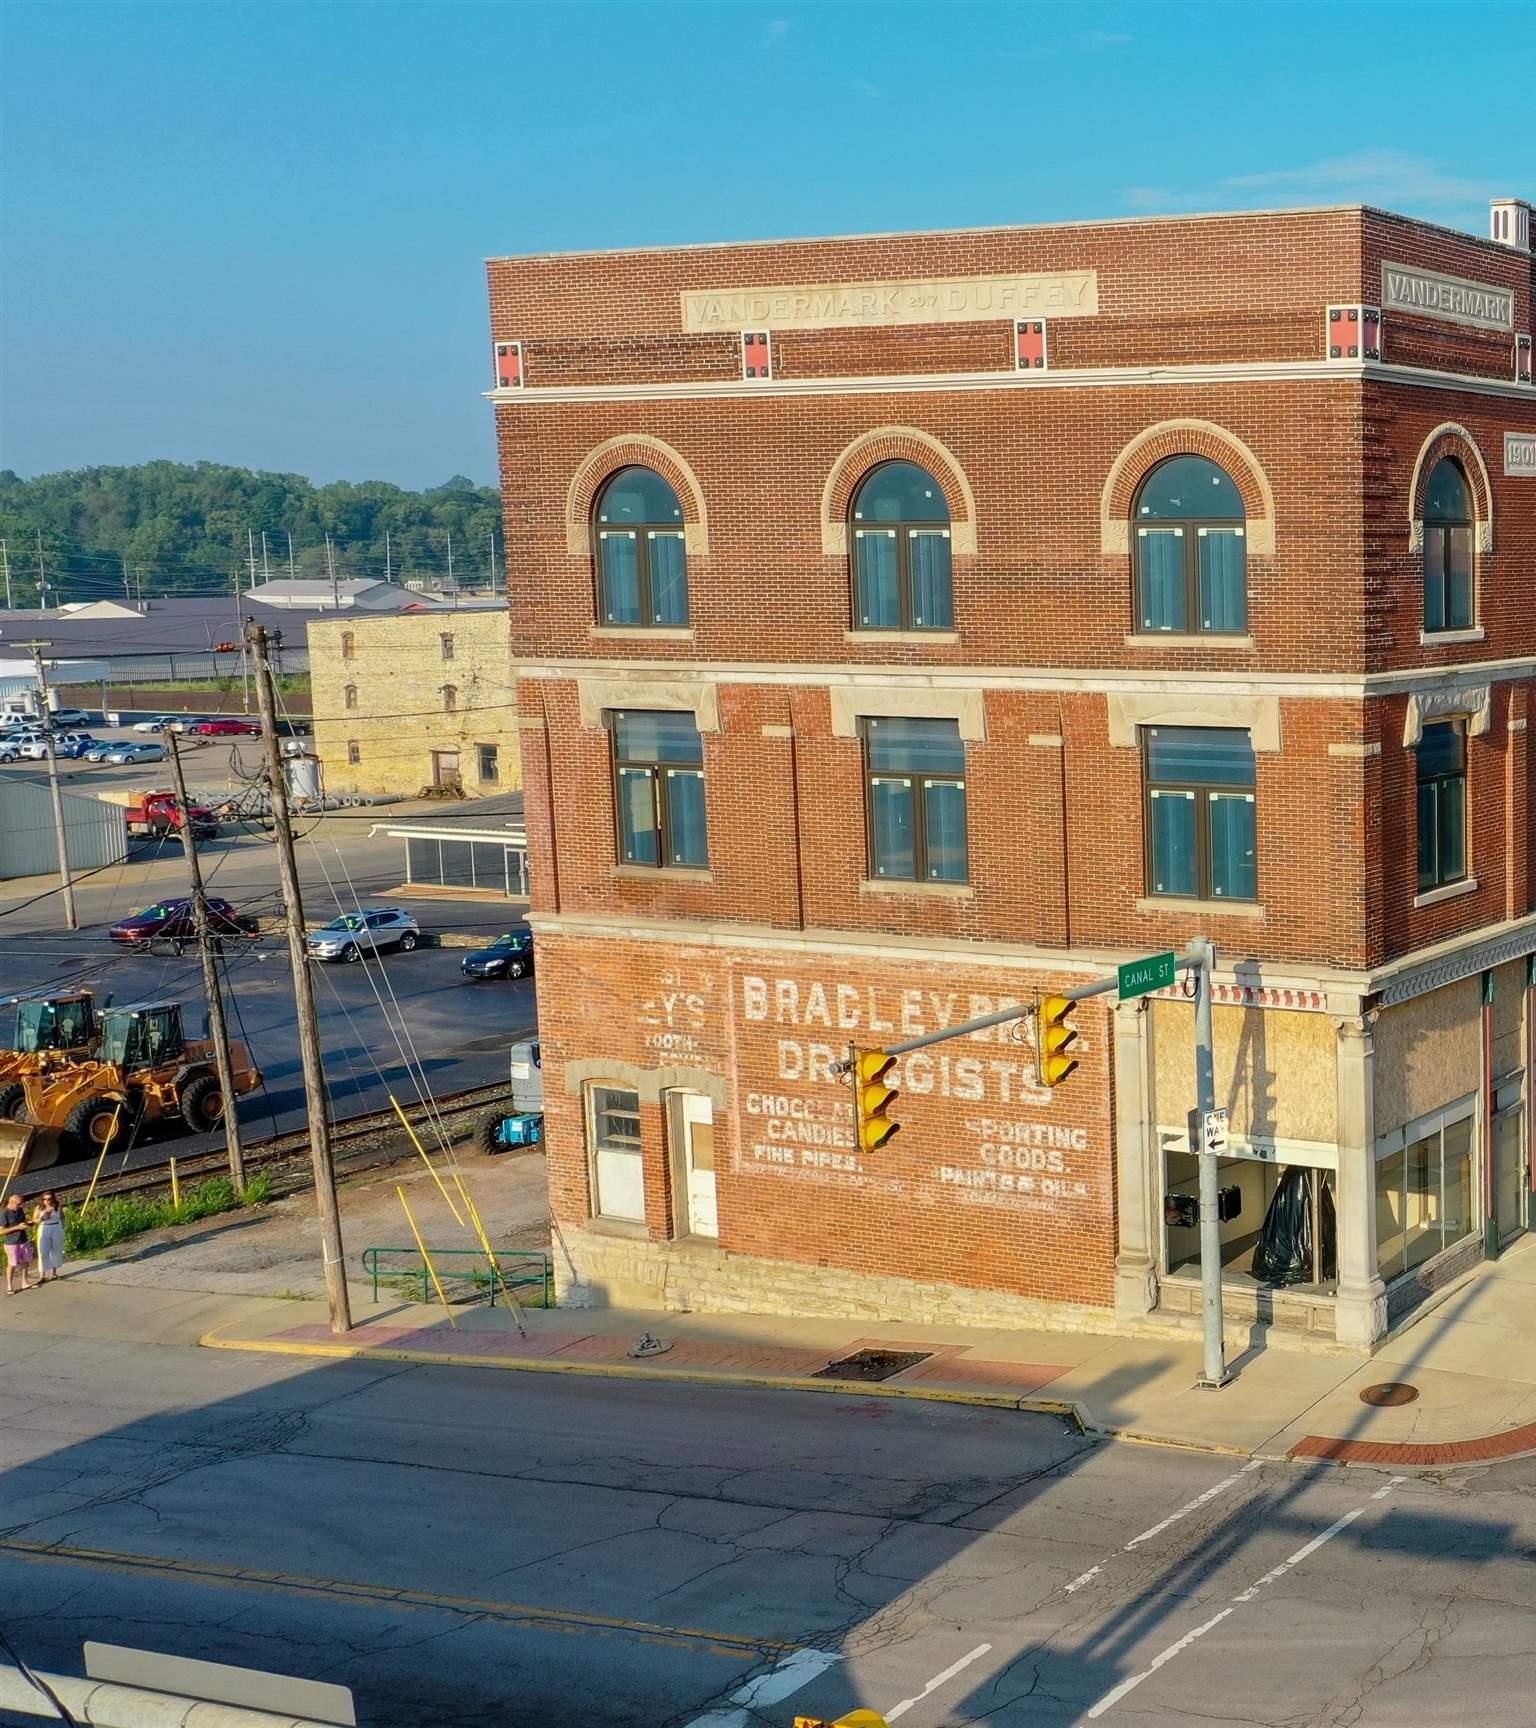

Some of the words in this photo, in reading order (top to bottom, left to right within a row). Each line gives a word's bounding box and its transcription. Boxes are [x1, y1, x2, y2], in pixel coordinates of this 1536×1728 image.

[690, 289, 901, 323] VANDERMARK
[909, 295, 938, 308] 2017
[945, 280, 1089, 312] DUFFEY
[1387, 272, 1508, 321] VANDERMARK
[1507, 442, 1536, 466] 1901
[1124, 968, 1154, 988] CANAL
[1158, 963, 1169, 978] ST
[743, 976, 958, 1037] BRADLEY
[1206, 1126, 1224, 1138] WA
[753, 1144, 795, 1164] FINE
